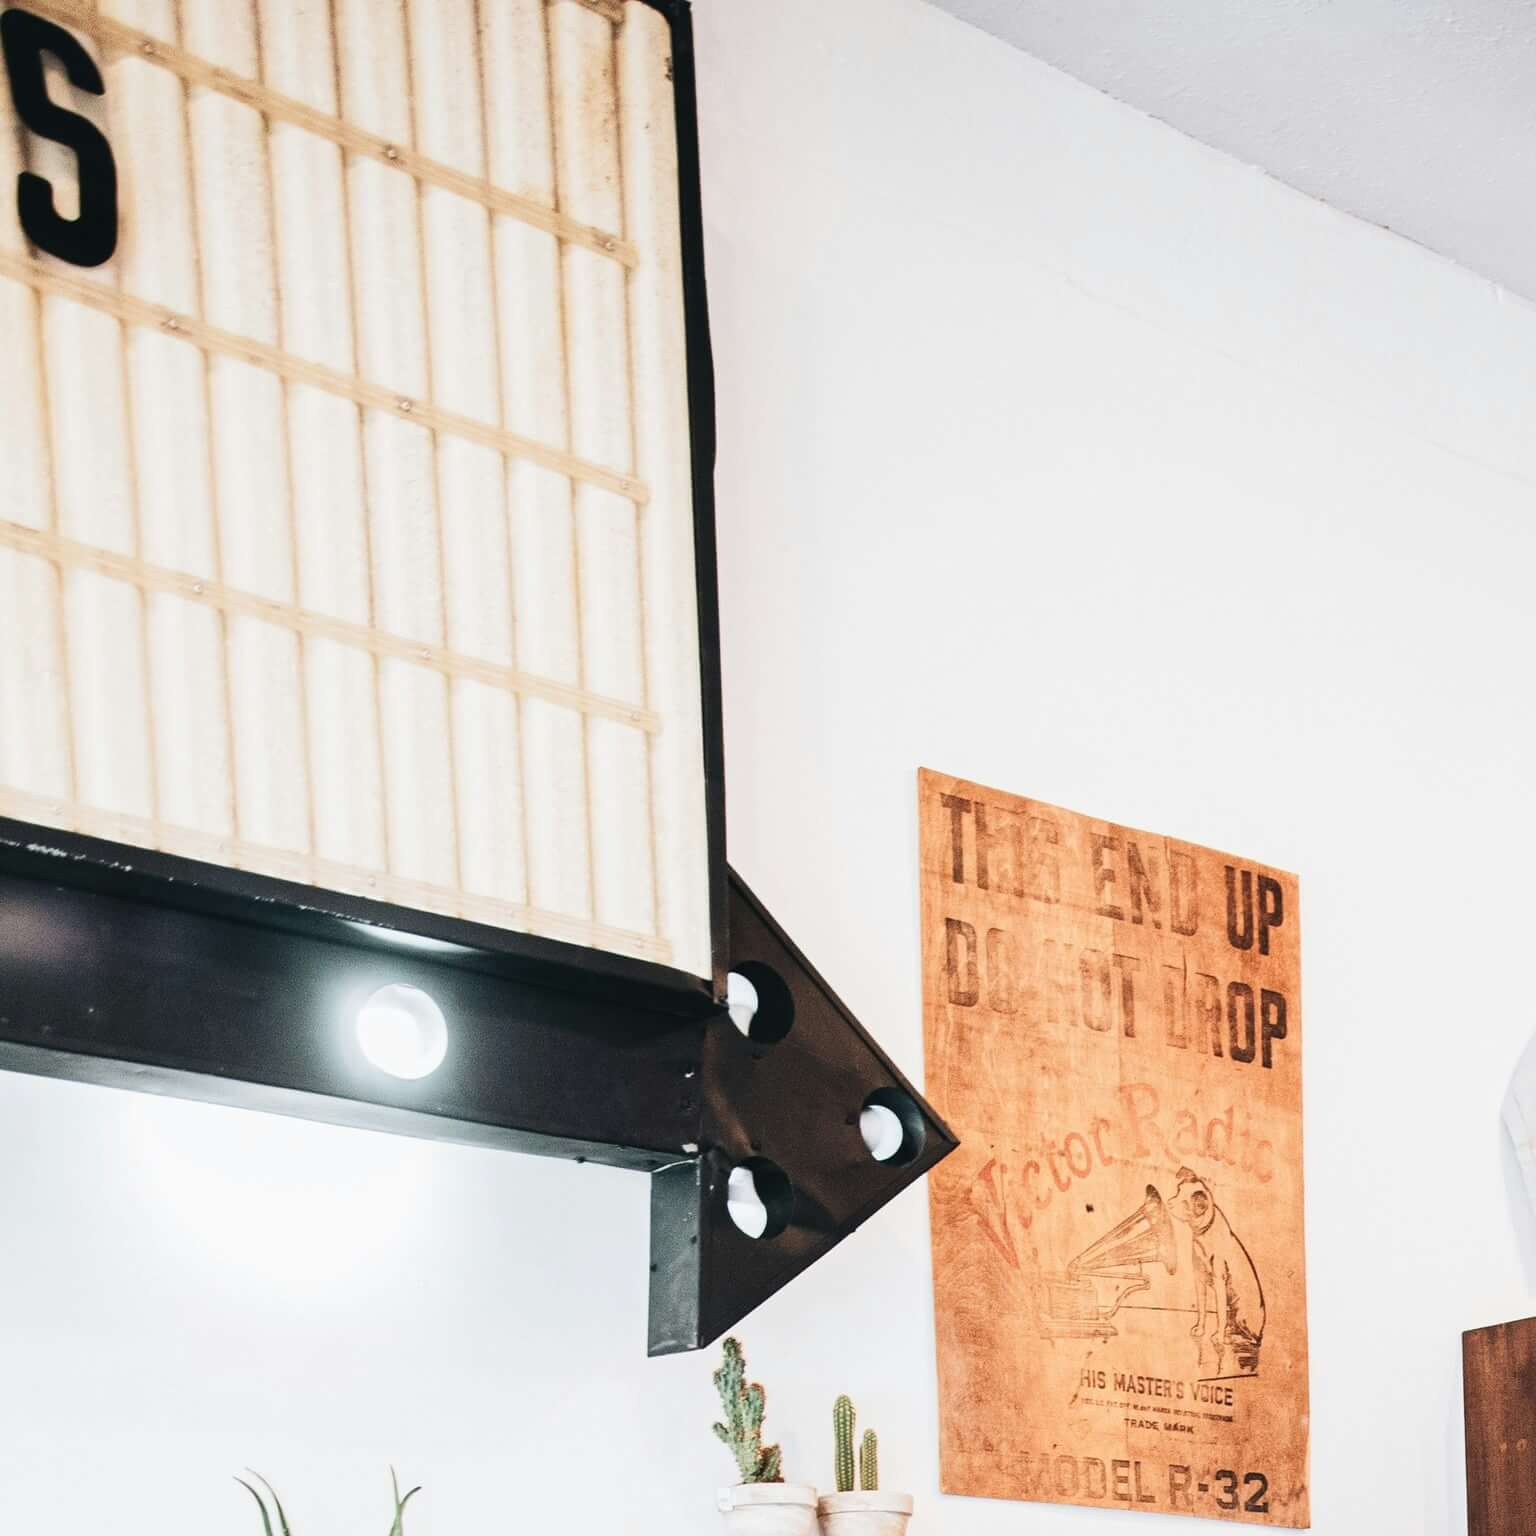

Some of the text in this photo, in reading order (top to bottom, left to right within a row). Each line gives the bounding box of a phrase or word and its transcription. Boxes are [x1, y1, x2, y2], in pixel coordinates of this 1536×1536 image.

[0, 8, 118, 267] S
[939, 792, 1284, 956] THIS END UP
[945, 917, 1019, 1015] DO
[1163, 963, 1289, 1069] DROP
[1080, 1368, 1233, 1407] HIS MASTER'S VOICE
[1124, 1417, 1196, 1436] TRADE MARK
[1168, 1463, 1269, 1513] R-32
